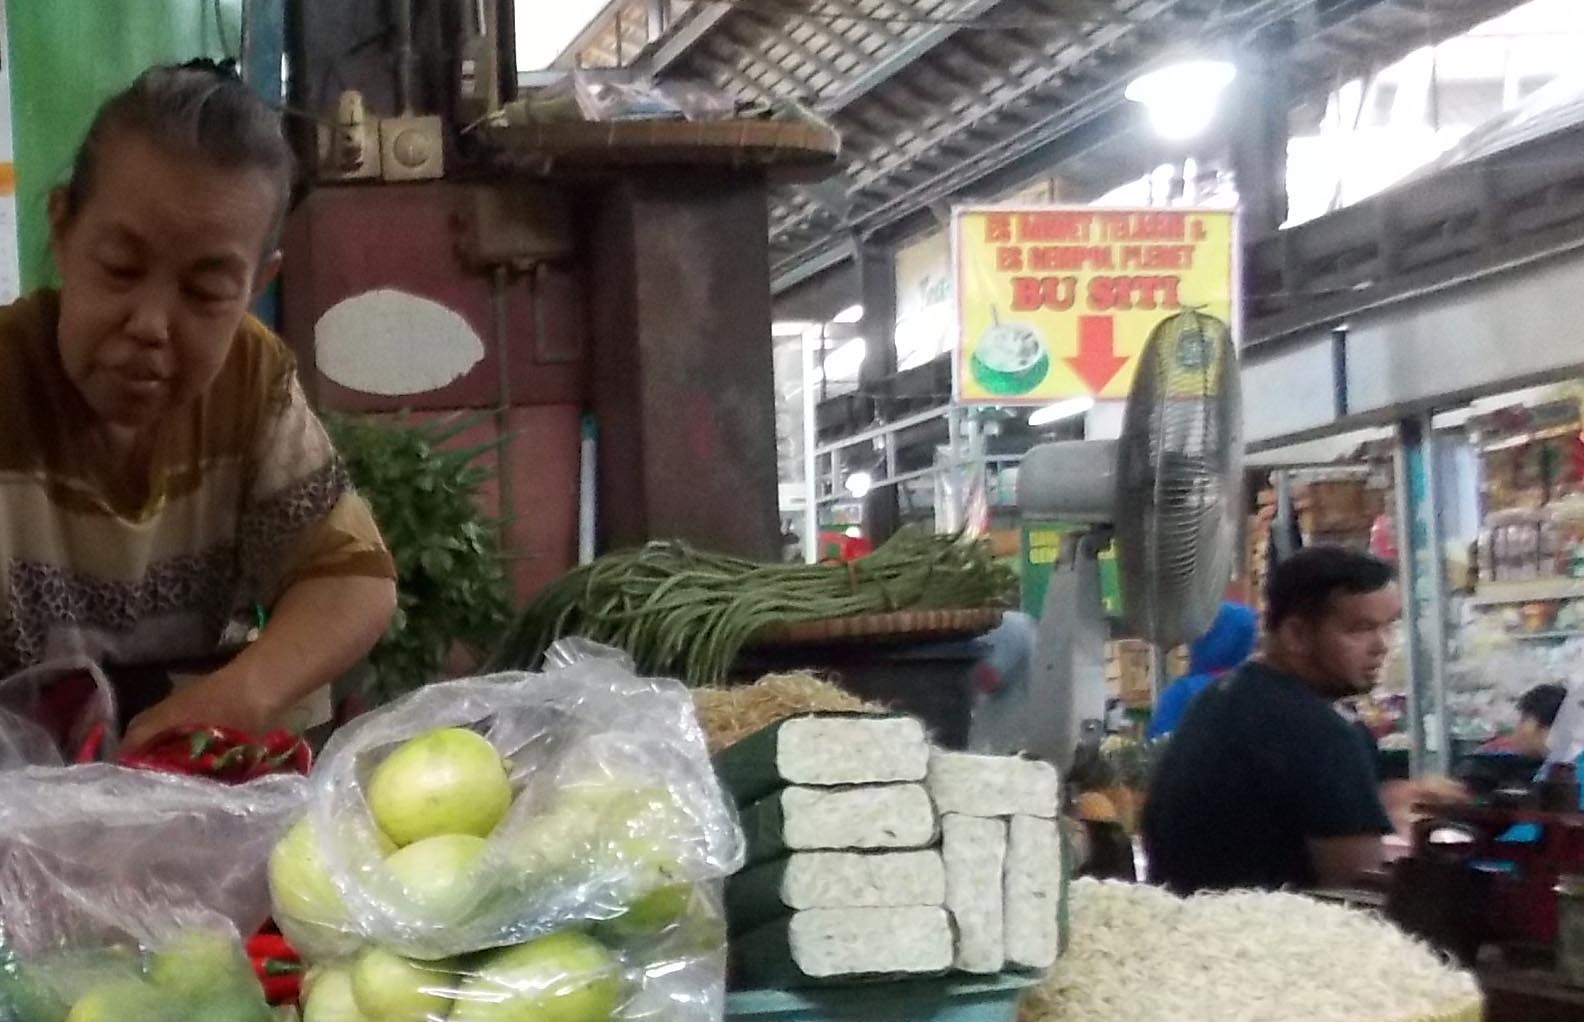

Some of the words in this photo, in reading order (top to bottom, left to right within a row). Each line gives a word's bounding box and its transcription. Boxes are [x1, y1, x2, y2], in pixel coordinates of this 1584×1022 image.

[996, 246, 1023, 271] ES
[1011, 275, 1077, 311] BU
[1087, 275, 1182, 311] SITI
